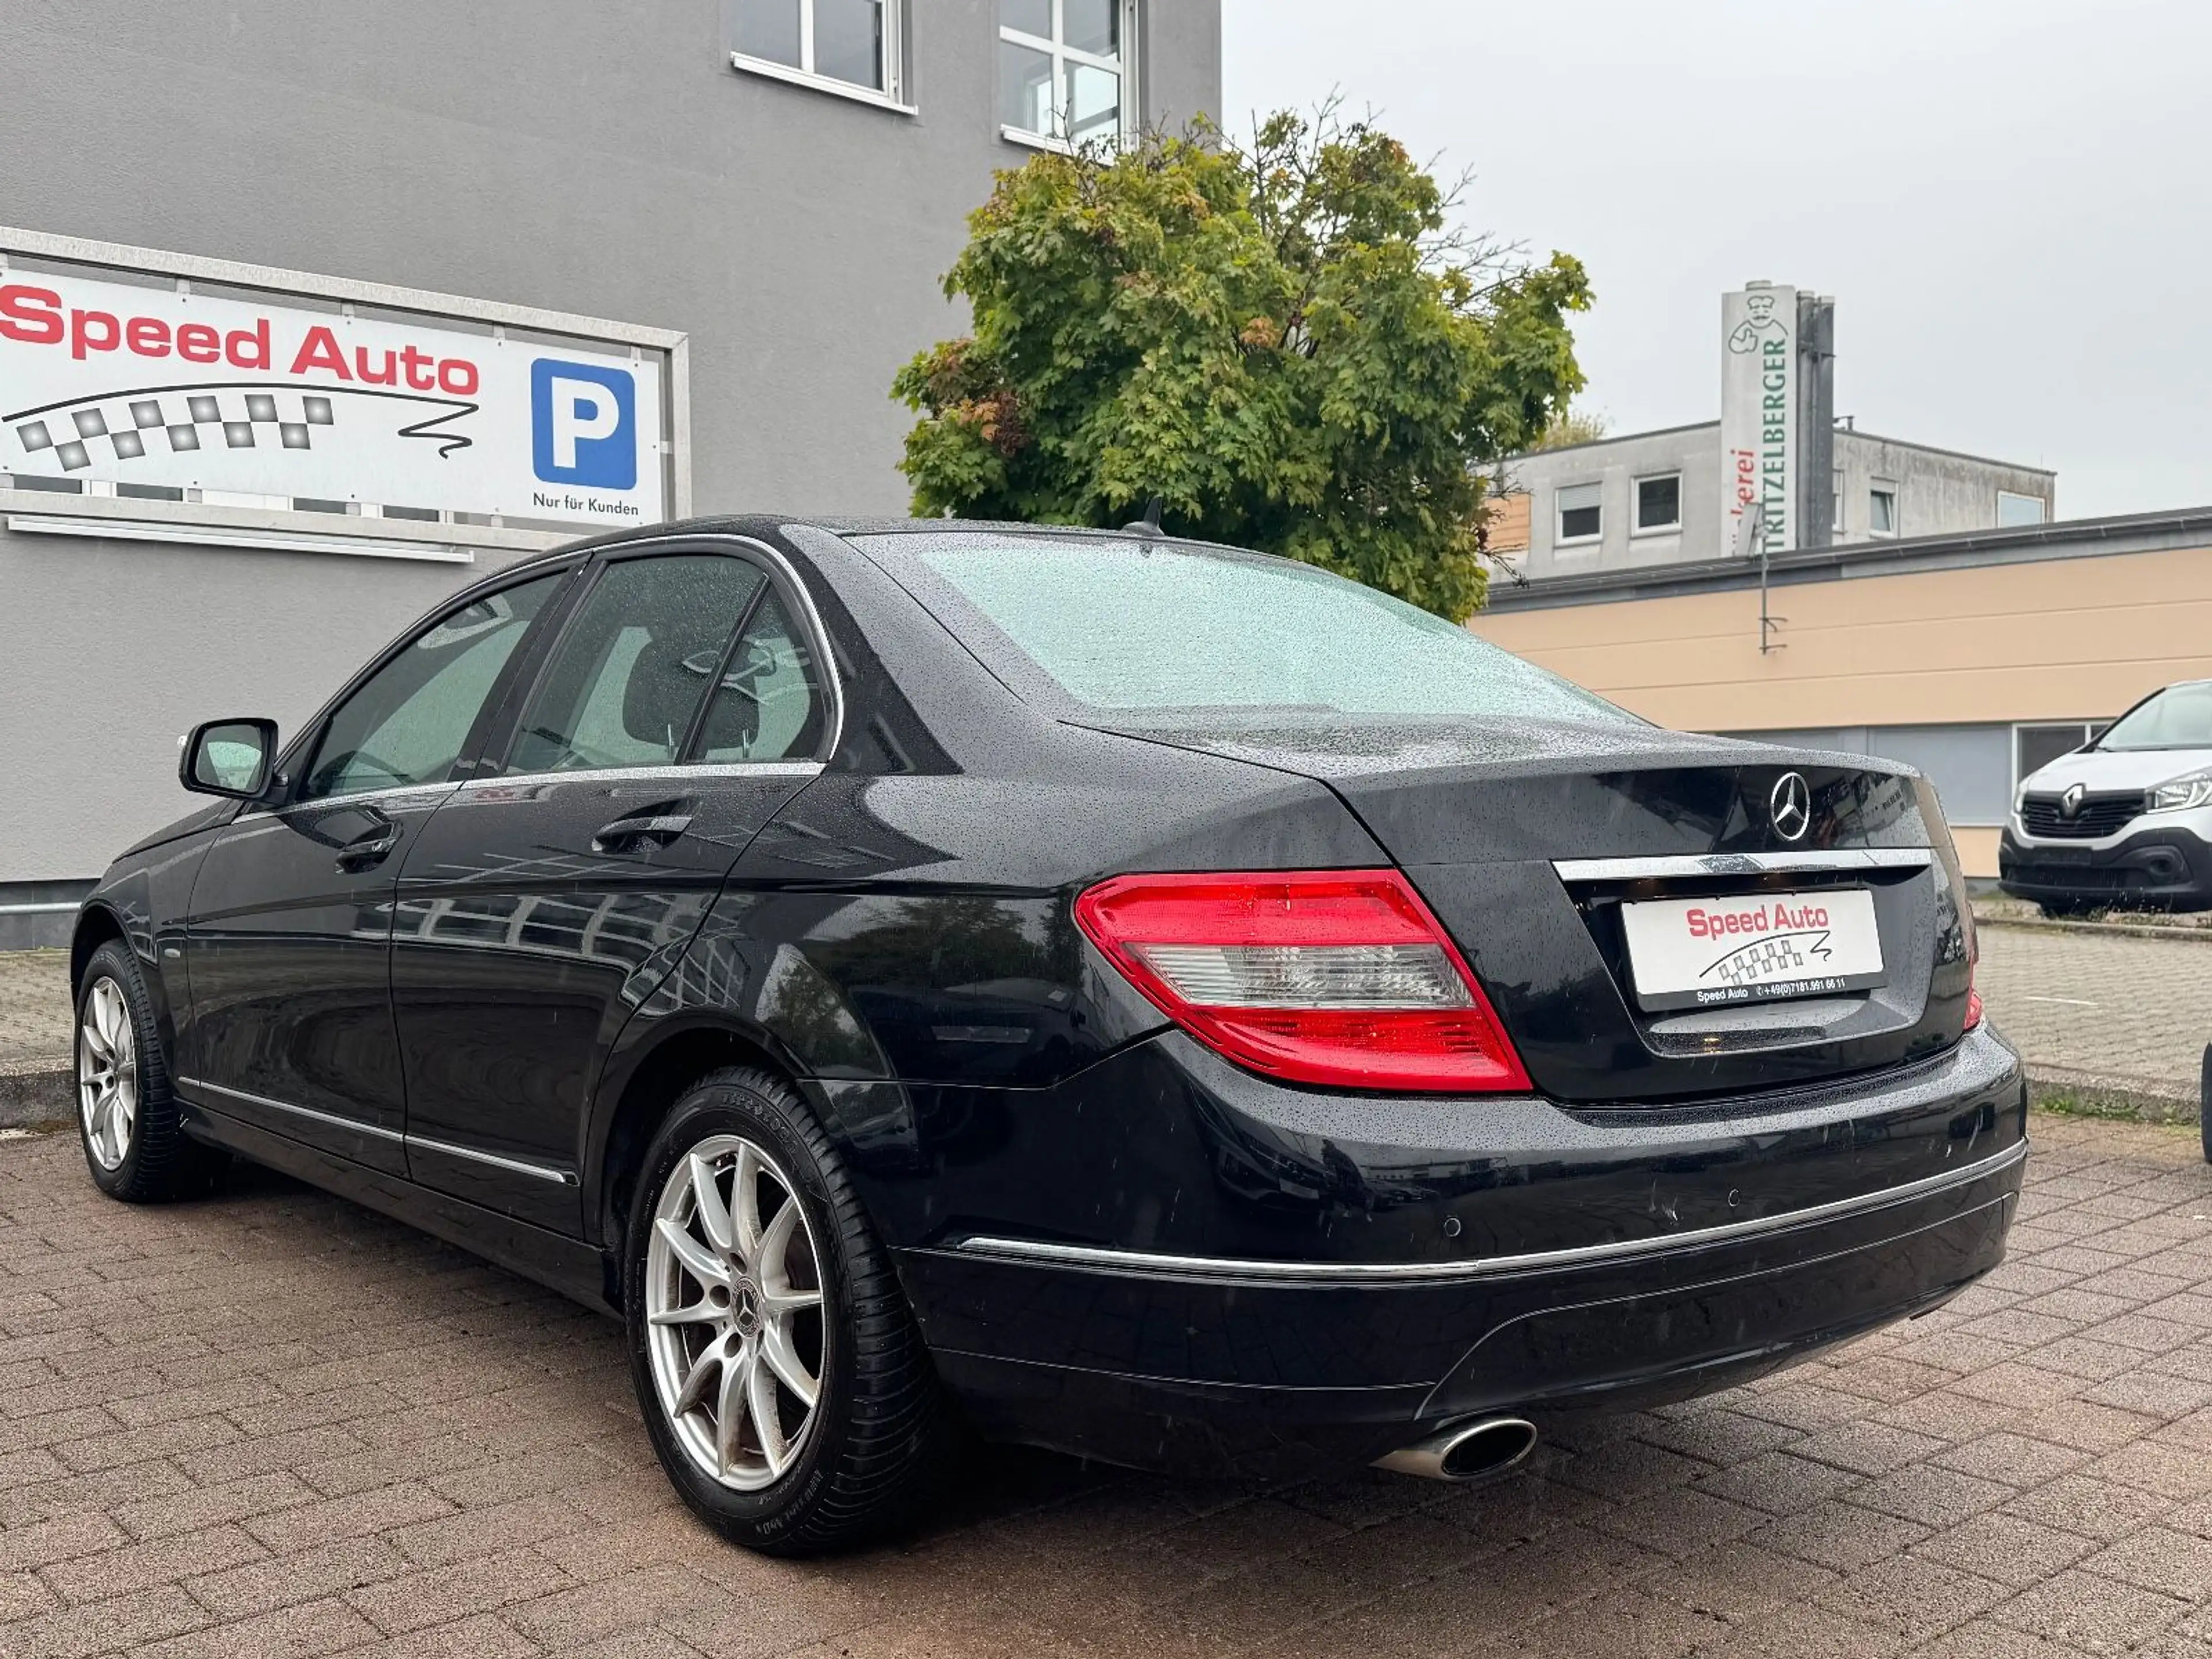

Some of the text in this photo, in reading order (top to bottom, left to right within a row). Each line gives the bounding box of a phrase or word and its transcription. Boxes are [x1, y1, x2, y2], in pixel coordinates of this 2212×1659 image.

[0, 285, 479, 395] Speed Auto
[551, 376, 619, 468] P
[533, 493, 639, 516] Nur für Kunden
[1686, 904, 1829, 940] Speed Auto
[1697, 988, 1726, 1003] Speed
[1728, 988, 1748, 999] Auto
[1836, 977, 1845, 988] 11
